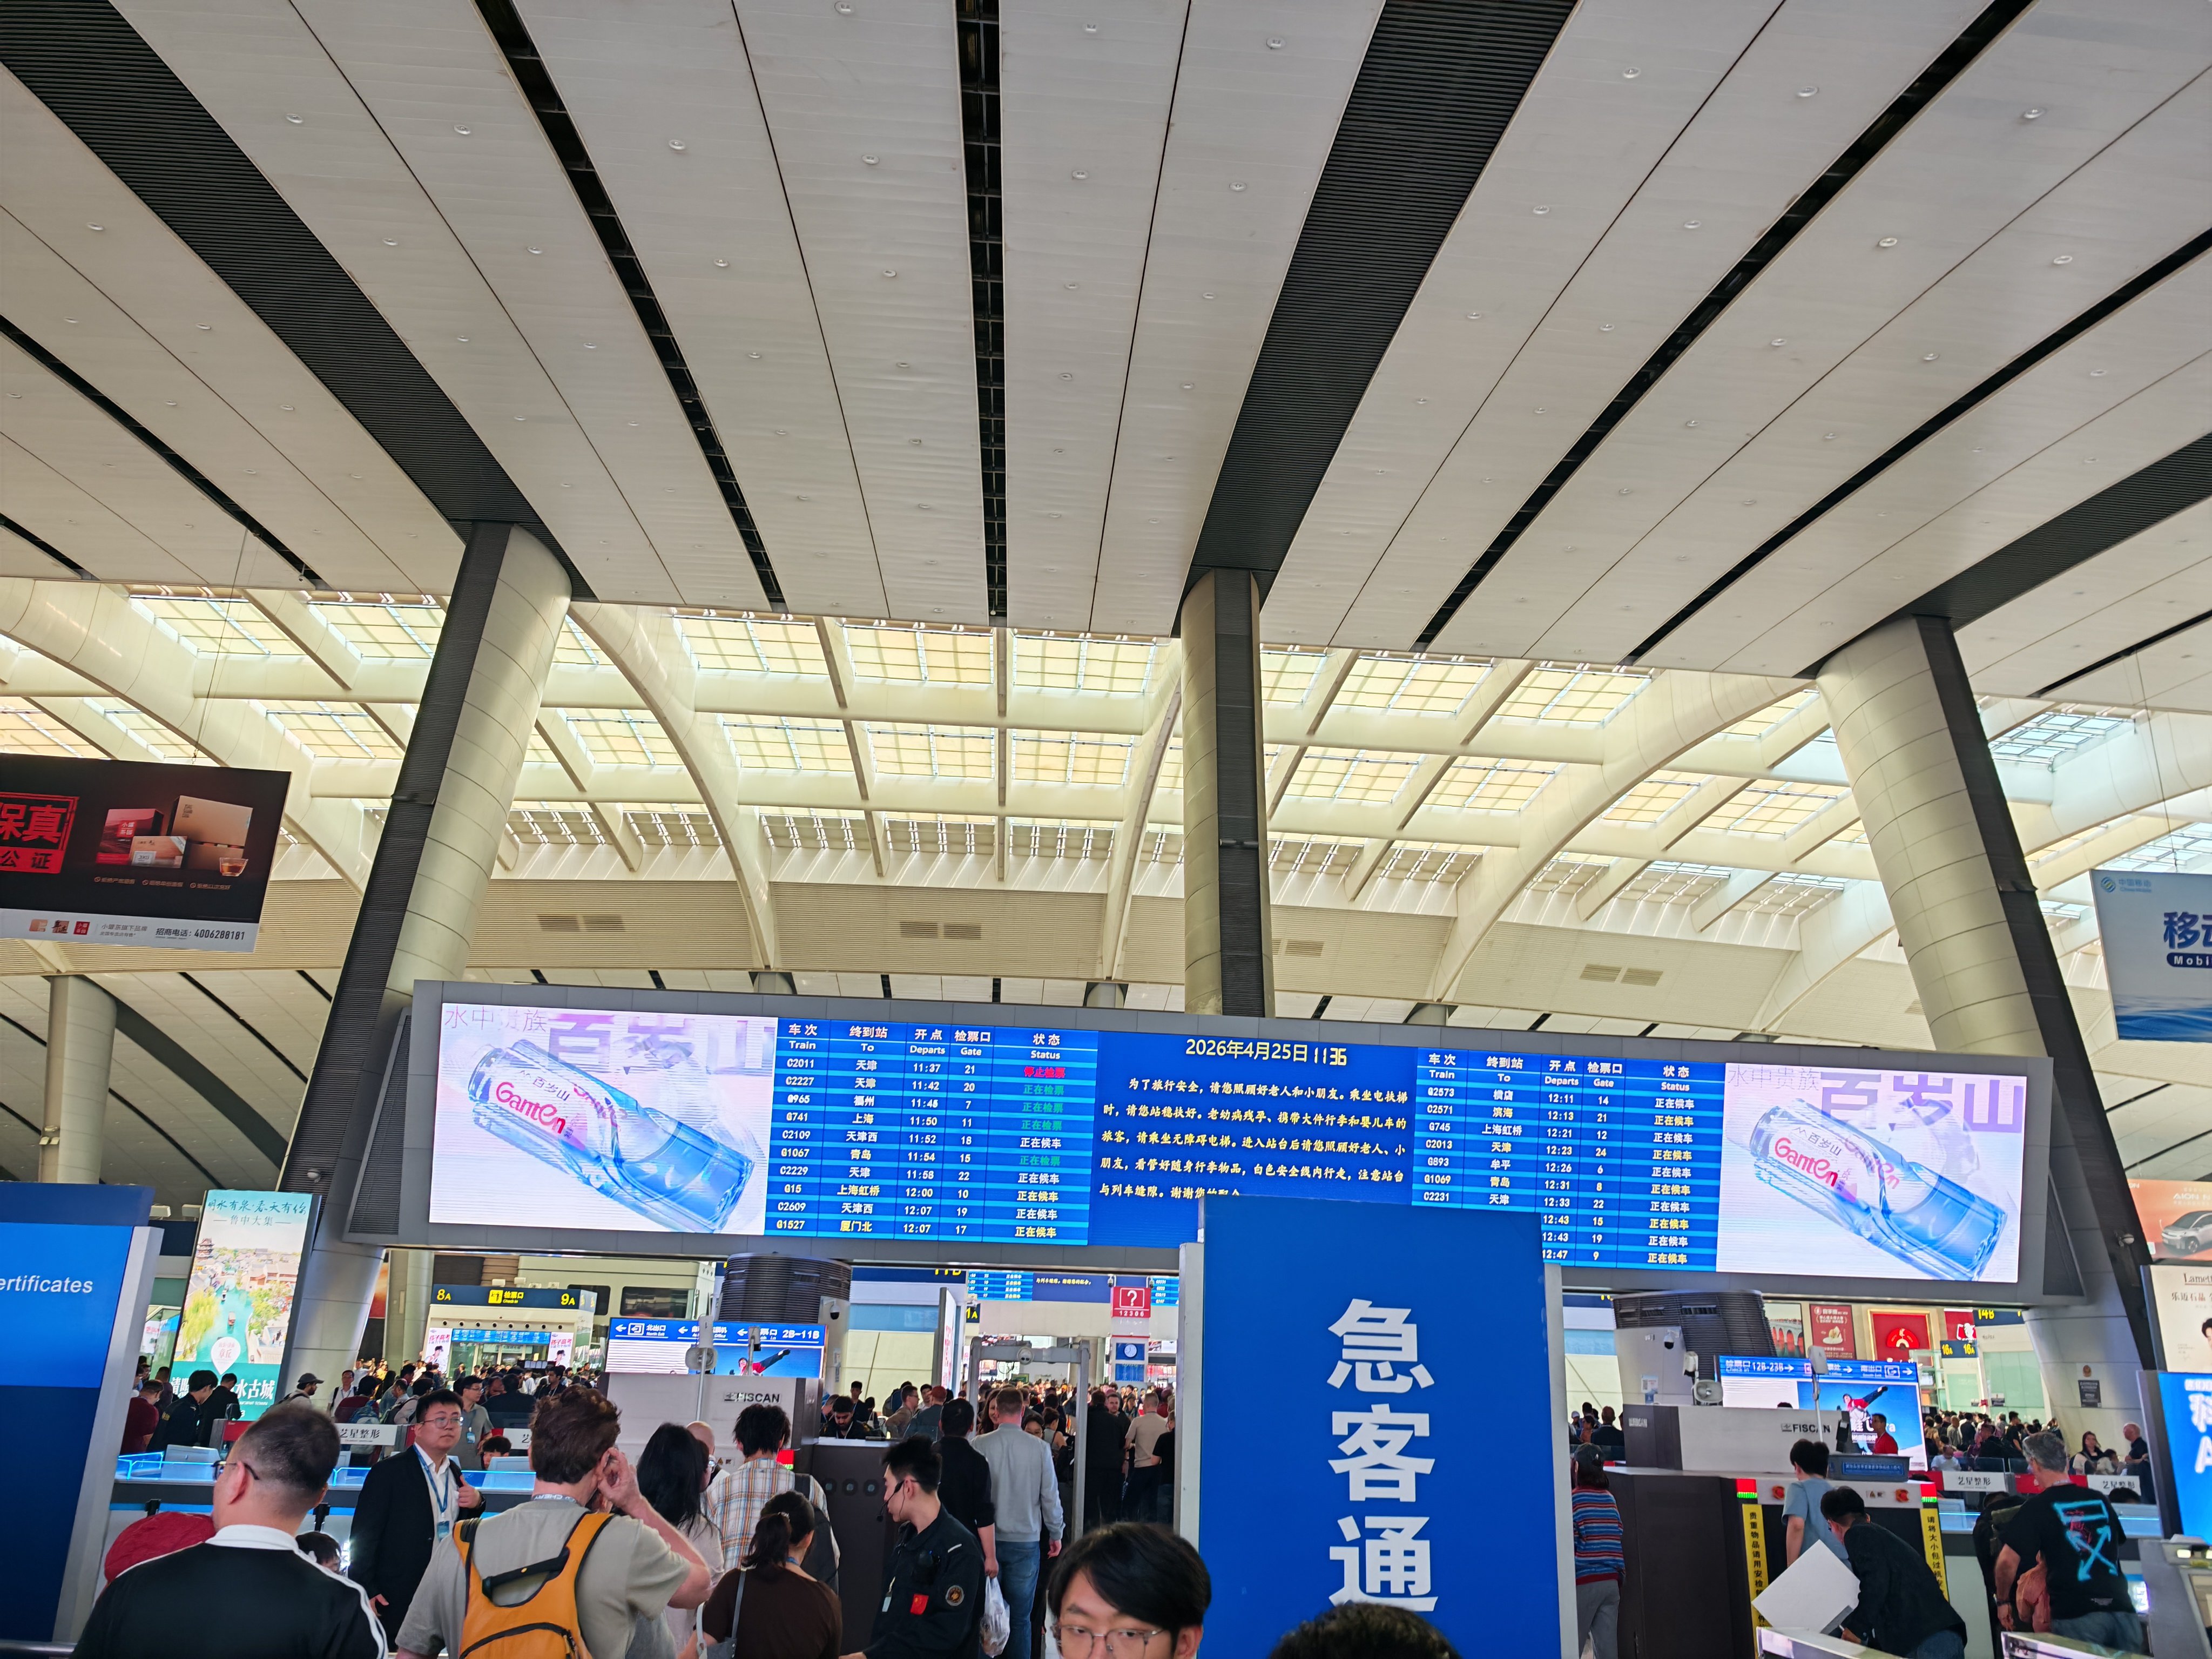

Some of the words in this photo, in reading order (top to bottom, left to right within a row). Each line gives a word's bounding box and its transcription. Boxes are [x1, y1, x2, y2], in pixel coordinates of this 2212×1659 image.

[194, 928, 245, 940] 4006288181
[954, 1030, 990, 1042] 检票口
[788, 1040, 816, 1050] Train
[861, 1043, 874, 1051] To
[909, 1045, 946, 1055] Departs
[960, 1047, 982, 1057] Gate
[1030, 1050, 1061, 1060] Status
[1185, 1038, 1307, 1062] 2026年4月25日
[787, 1058, 814, 1068] C2011
[855, 1060, 878, 1071] 天津
[914, 1063, 941, 1073] 11:37
[965, 1064, 975, 1074] 21
[1587, 1061, 1622, 1074] 检票口
[785, 1076, 814, 1086] C2227
[854, 1077, 876, 1089] 天津
[912, 1081, 940, 1090] 11:42
[963, 1082, 975, 1092] 20
[1023, 1084, 1064, 1096] 正在检票
[1428, 1069, 1455, 1079] Train
[1498, 1073, 1510, 1082] To
[1545, 1076, 1579, 1086] Departs
[1593, 1078, 1614, 1088] Gate
[1661, 1082, 1690, 1091] Status
[966, 1101, 972, 1109] 7
[1022, 1102, 1063, 1114] 正在检票
[1548, 1094, 1573, 1103] 12:11
[1598, 1096, 1609, 1105] 14
[1655, 1098, 1695, 1110] 正在候车
[1427, 1104, 1453, 1114] C2571
[1548, 1111, 1574, 1121] 12:13
[1597, 1113, 1607, 1122] 21
[852, 1113, 874, 1124] 上海
[910, 1116, 938, 1126] 11:50
[962, 1118, 972, 1127] 11
[1021, 1119, 1062, 1132] 正在检票
[782, 1130, 811, 1139] C2109
[846, 1131, 878, 1142] 天津西
[909, 1134, 936, 1144] 11:52
[961, 1136, 972, 1145] 18
[1020, 1137, 1062, 1149] 正在候车
[1429, 1122, 1451, 1132] G745
[1481, 1123, 1522, 1136] 上海虹桥
[1547, 1128, 1572, 1138] 12:21
[1597, 1130, 1607, 1139] 12
[1653, 1132, 1693, 1144] 正在候车
[1426, 1139, 1452, 1149] C2013
[1491, 1142, 1512, 1153] 天津
[1546, 1145, 1572, 1155] 12:23
[1595, 1148, 1607, 1157] 24
[850, 1149, 871, 1160] 青岛
[908, 1152, 935, 1162] 11:54
[960, 1154, 970, 1163] 15
[1019, 1155, 1061, 1167] 正在检票
[1427, 1157, 1449, 1166] G893
[1490, 1159, 1511, 1170] 牟平
[1546, 1163, 1572, 1172] 12:26
[1597, 1165, 1603, 1174] 6
[780, 1166, 808, 1175] C2229
[849, 1166, 871, 1178] 天津
[907, 1170, 934, 1179] 11:58
[958, 1171, 969, 1181] 22
[837, 1184, 880, 1196] 上海虹桥
[906, 1188, 933, 1197] 12:00
[958, 1189, 969, 1198] 10
[1016, 1190, 1058, 1203] 正在候车
[1424, 1174, 1451, 1184] G1069
[1490, 1176, 1510, 1188] 青岛
[1545, 1180, 1570, 1190] 12:31
[1596, 1182, 1602, 1191] 8
[1650, 1184, 1691, 1196] 正在候车
[1424, 1191, 1449, 1202] C2231
[1489, 1193, 1509, 1205] 天津
[1544, 1197, 1570, 1207] 12:33
[1593, 1199, 1604, 1209] 22
[778, 1202, 806, 1211] C2609
[841, 1202, 873, 1214] 天津西
[905, 1205, 932, 1215] 12:07
[957, 1207, 968, 1217] 19
[840, 1220, 872, 1232] 厦门北
[903, 1224, 931, 1233] 12:07
[955, 1225, 967, 1235] 17
[1543, 1215, 1569, 1225] 12:43
[1593, 1217, 1603, 1226] 15
[1649, 1218, 1689, 1230] 正在候车
[1542, 1232, 1568, 1242] 12:43
[1592, 1234, 1602, 1243] 19
[1542, 1249, 1568, 1259] 12:47
[1593, 1251, 1599, 1260] 9
[561, 1293, 576, 1306] 9A
[646, 1324, 666, 1332] 北出口
[1327, 1298, 1438, 1611] 急客通
